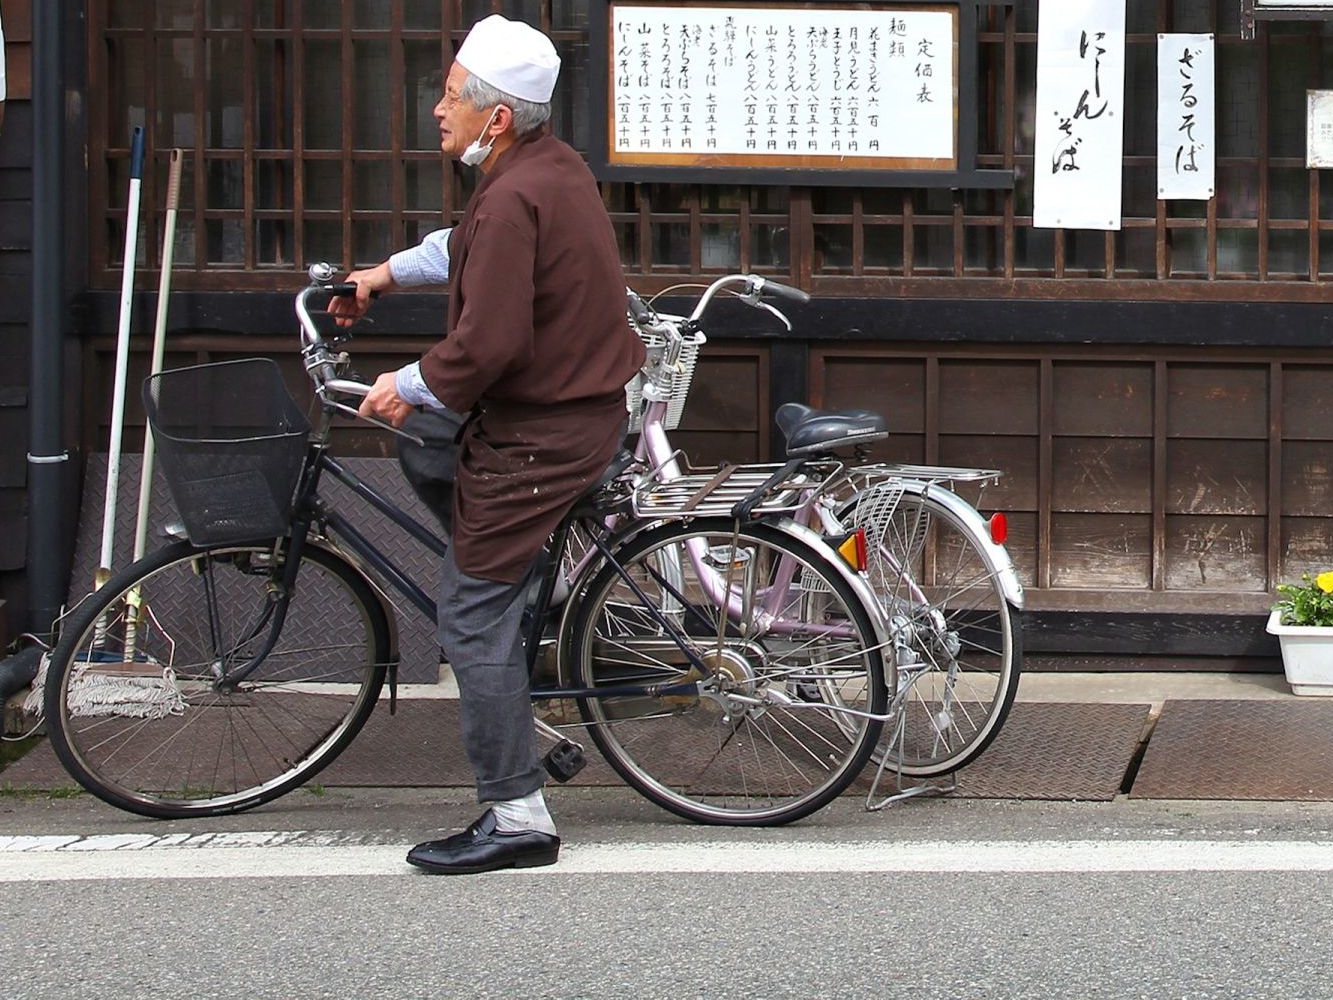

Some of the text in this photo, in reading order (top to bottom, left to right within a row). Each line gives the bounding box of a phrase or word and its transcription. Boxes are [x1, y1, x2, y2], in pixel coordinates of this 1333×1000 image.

[915, 38, 935, 103] 定価表
[1175, 48, 1204, 174] ざるそば
